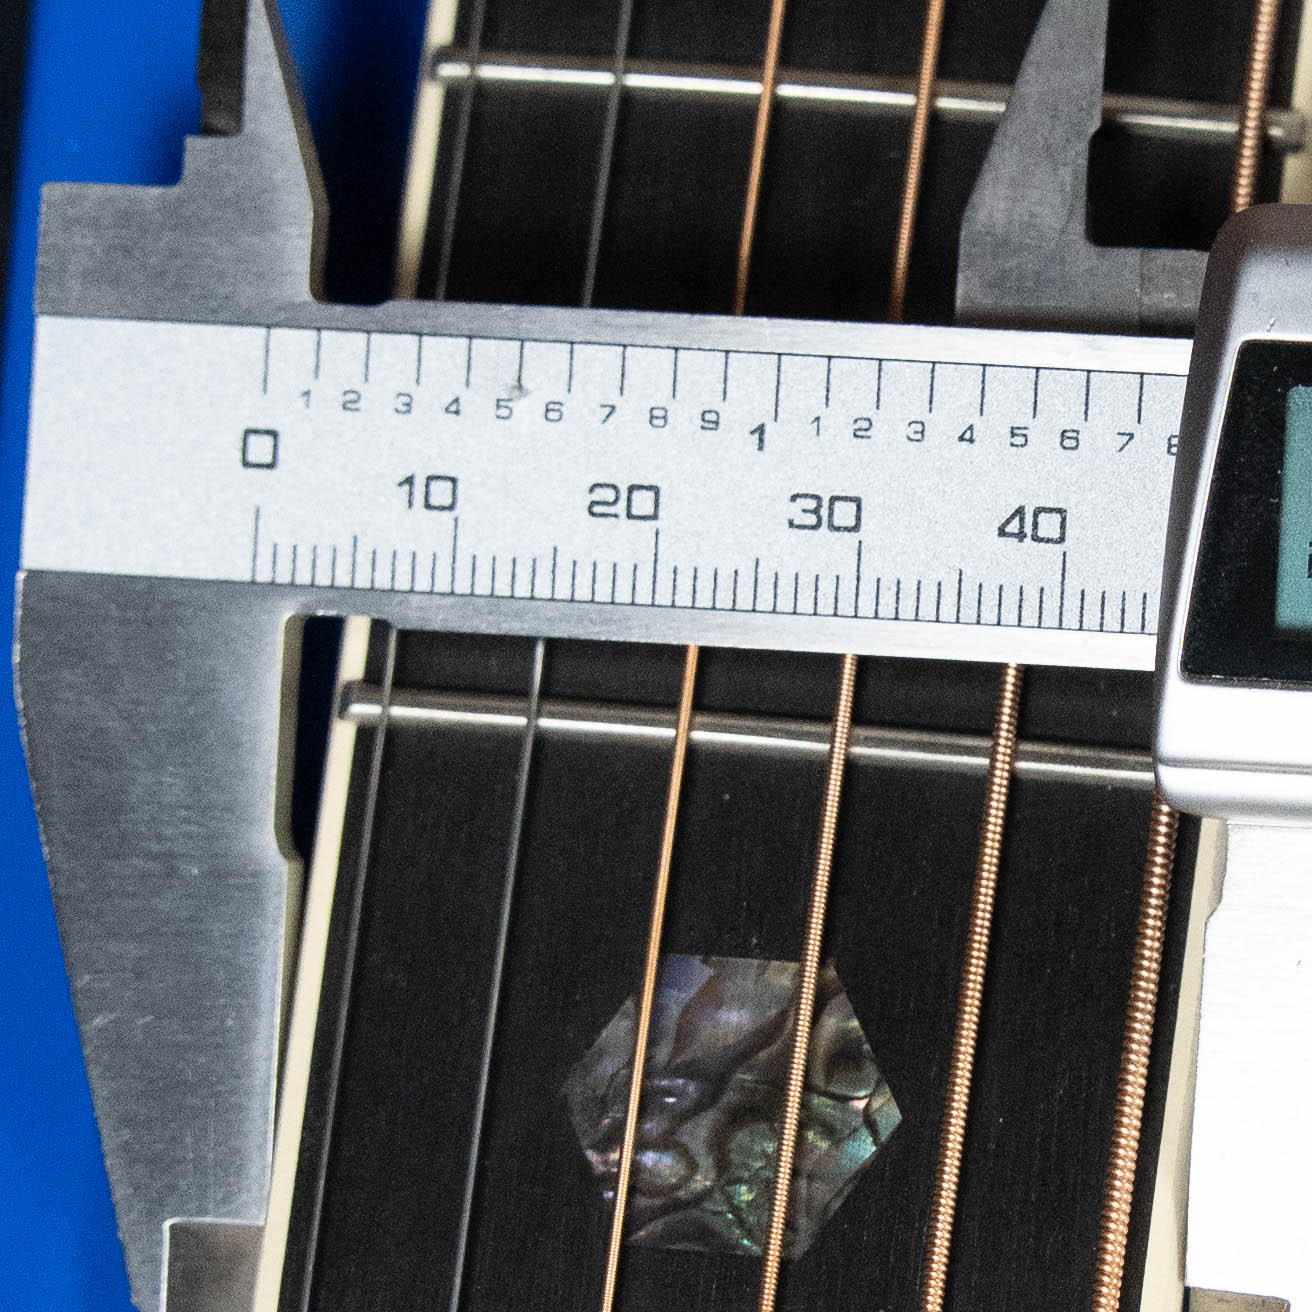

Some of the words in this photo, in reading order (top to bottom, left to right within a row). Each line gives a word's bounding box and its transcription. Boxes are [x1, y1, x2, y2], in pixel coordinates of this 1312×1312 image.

[300, 389, 312, 409] 1
[341, 389, 362, 411] 2
[394, 392, 414, 415] 3
[444, 395, 462, 417] 4
[495, 397, 514, 420] 5
[543, 400, 564, 423] 6
[600, 404, 617, 424] 7
[648, 406, 669, 428] 8
[700, 409, 720, 431] 9
[749, 422, 766, 452] 1
[810, 415, 822, 437] 1
[852, 417, 873, 440] 2
[906, 420, 926, 443] 3
[957, 423, 977, 445] 4
[1009, 425, 1029, 448] 5
[1059, 428, 1080, 451] 6
[1116, 431, 1135, 453] 7
[241, 428, 280, 470] 0
[397, 474, 458, 512] 10
[587, 482, 661, 521] 20
[787, 492, 863, 533] 30
[997, 505, 1068, 545] 40
